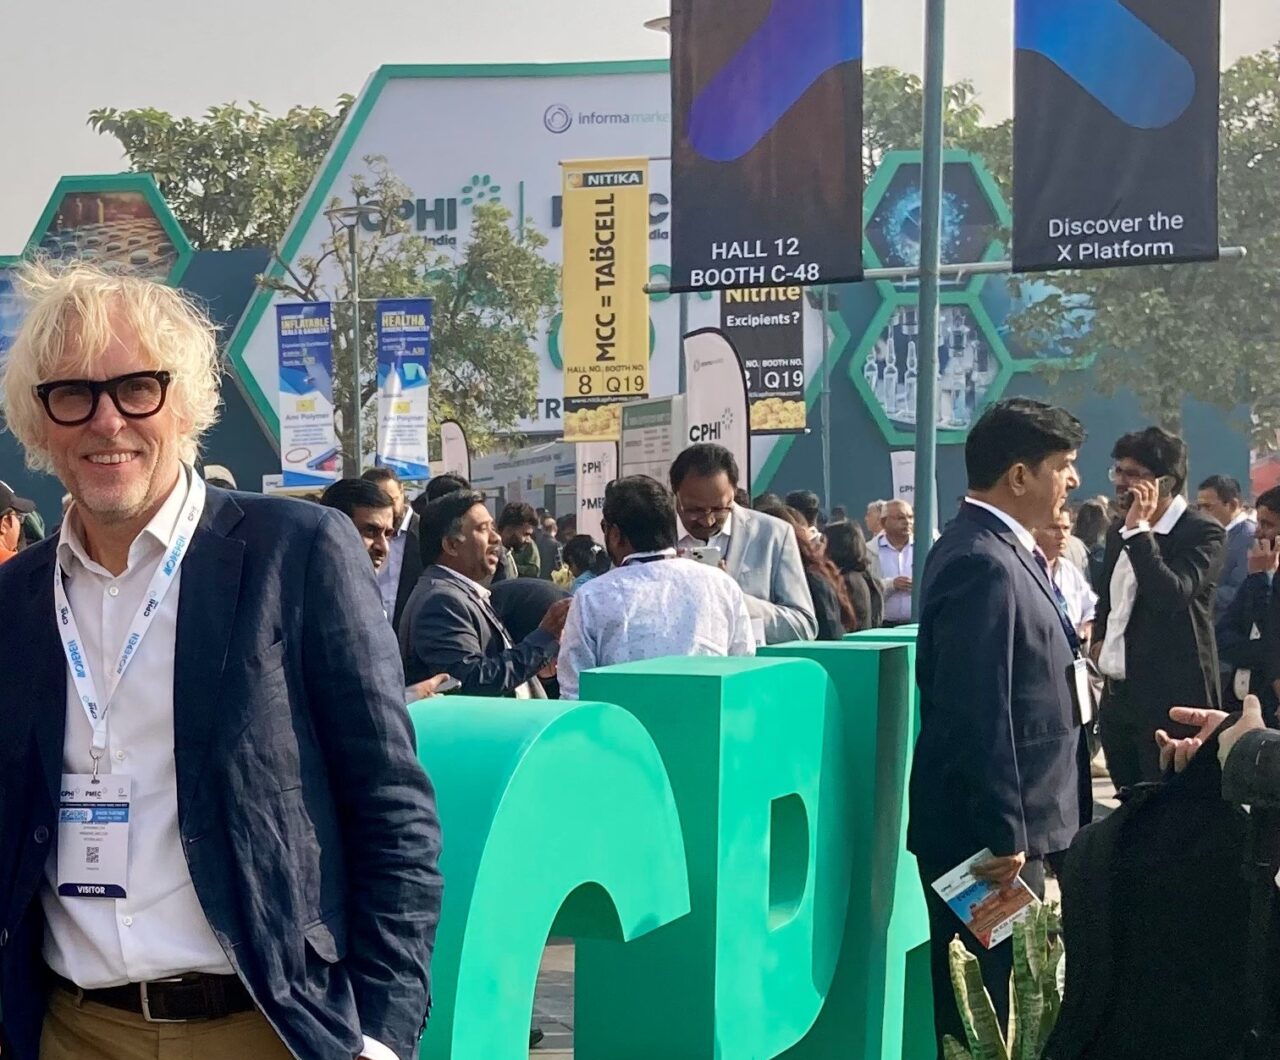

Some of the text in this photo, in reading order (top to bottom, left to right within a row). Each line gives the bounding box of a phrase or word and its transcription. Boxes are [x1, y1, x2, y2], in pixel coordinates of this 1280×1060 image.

[588, 173, 640, 185] NITIKA
[1049, 211, 1184, 237] Discover the
[649, 229, 669, 240] dia
[711, 237, 800, 260] HALL 12
[1057, 240, 1174, 261] X Platform
[690, 266, 765, 287] BOOTH
[771, 262, 820, 283] C-48
[281, 317, 330, 331] INFLATABLE
[726, 313, 790, 328] Excipients
[595, 312, 616, 362] MCC
[567, 365, 602, 374] HALL NO.
[605, 363, 645, 373] BOOTH NO.
[745, 359, 760, 368] NO.
[762, 358, 803, 368] BOOTH NO.
[578, 374, 592, 395] 8
[606, 375, 645, 393] Q19
[765, 370, 804, 389] Q19
[689, 421, 721, 443] CPHI
[76, 885, 106, 895] VISITOR
